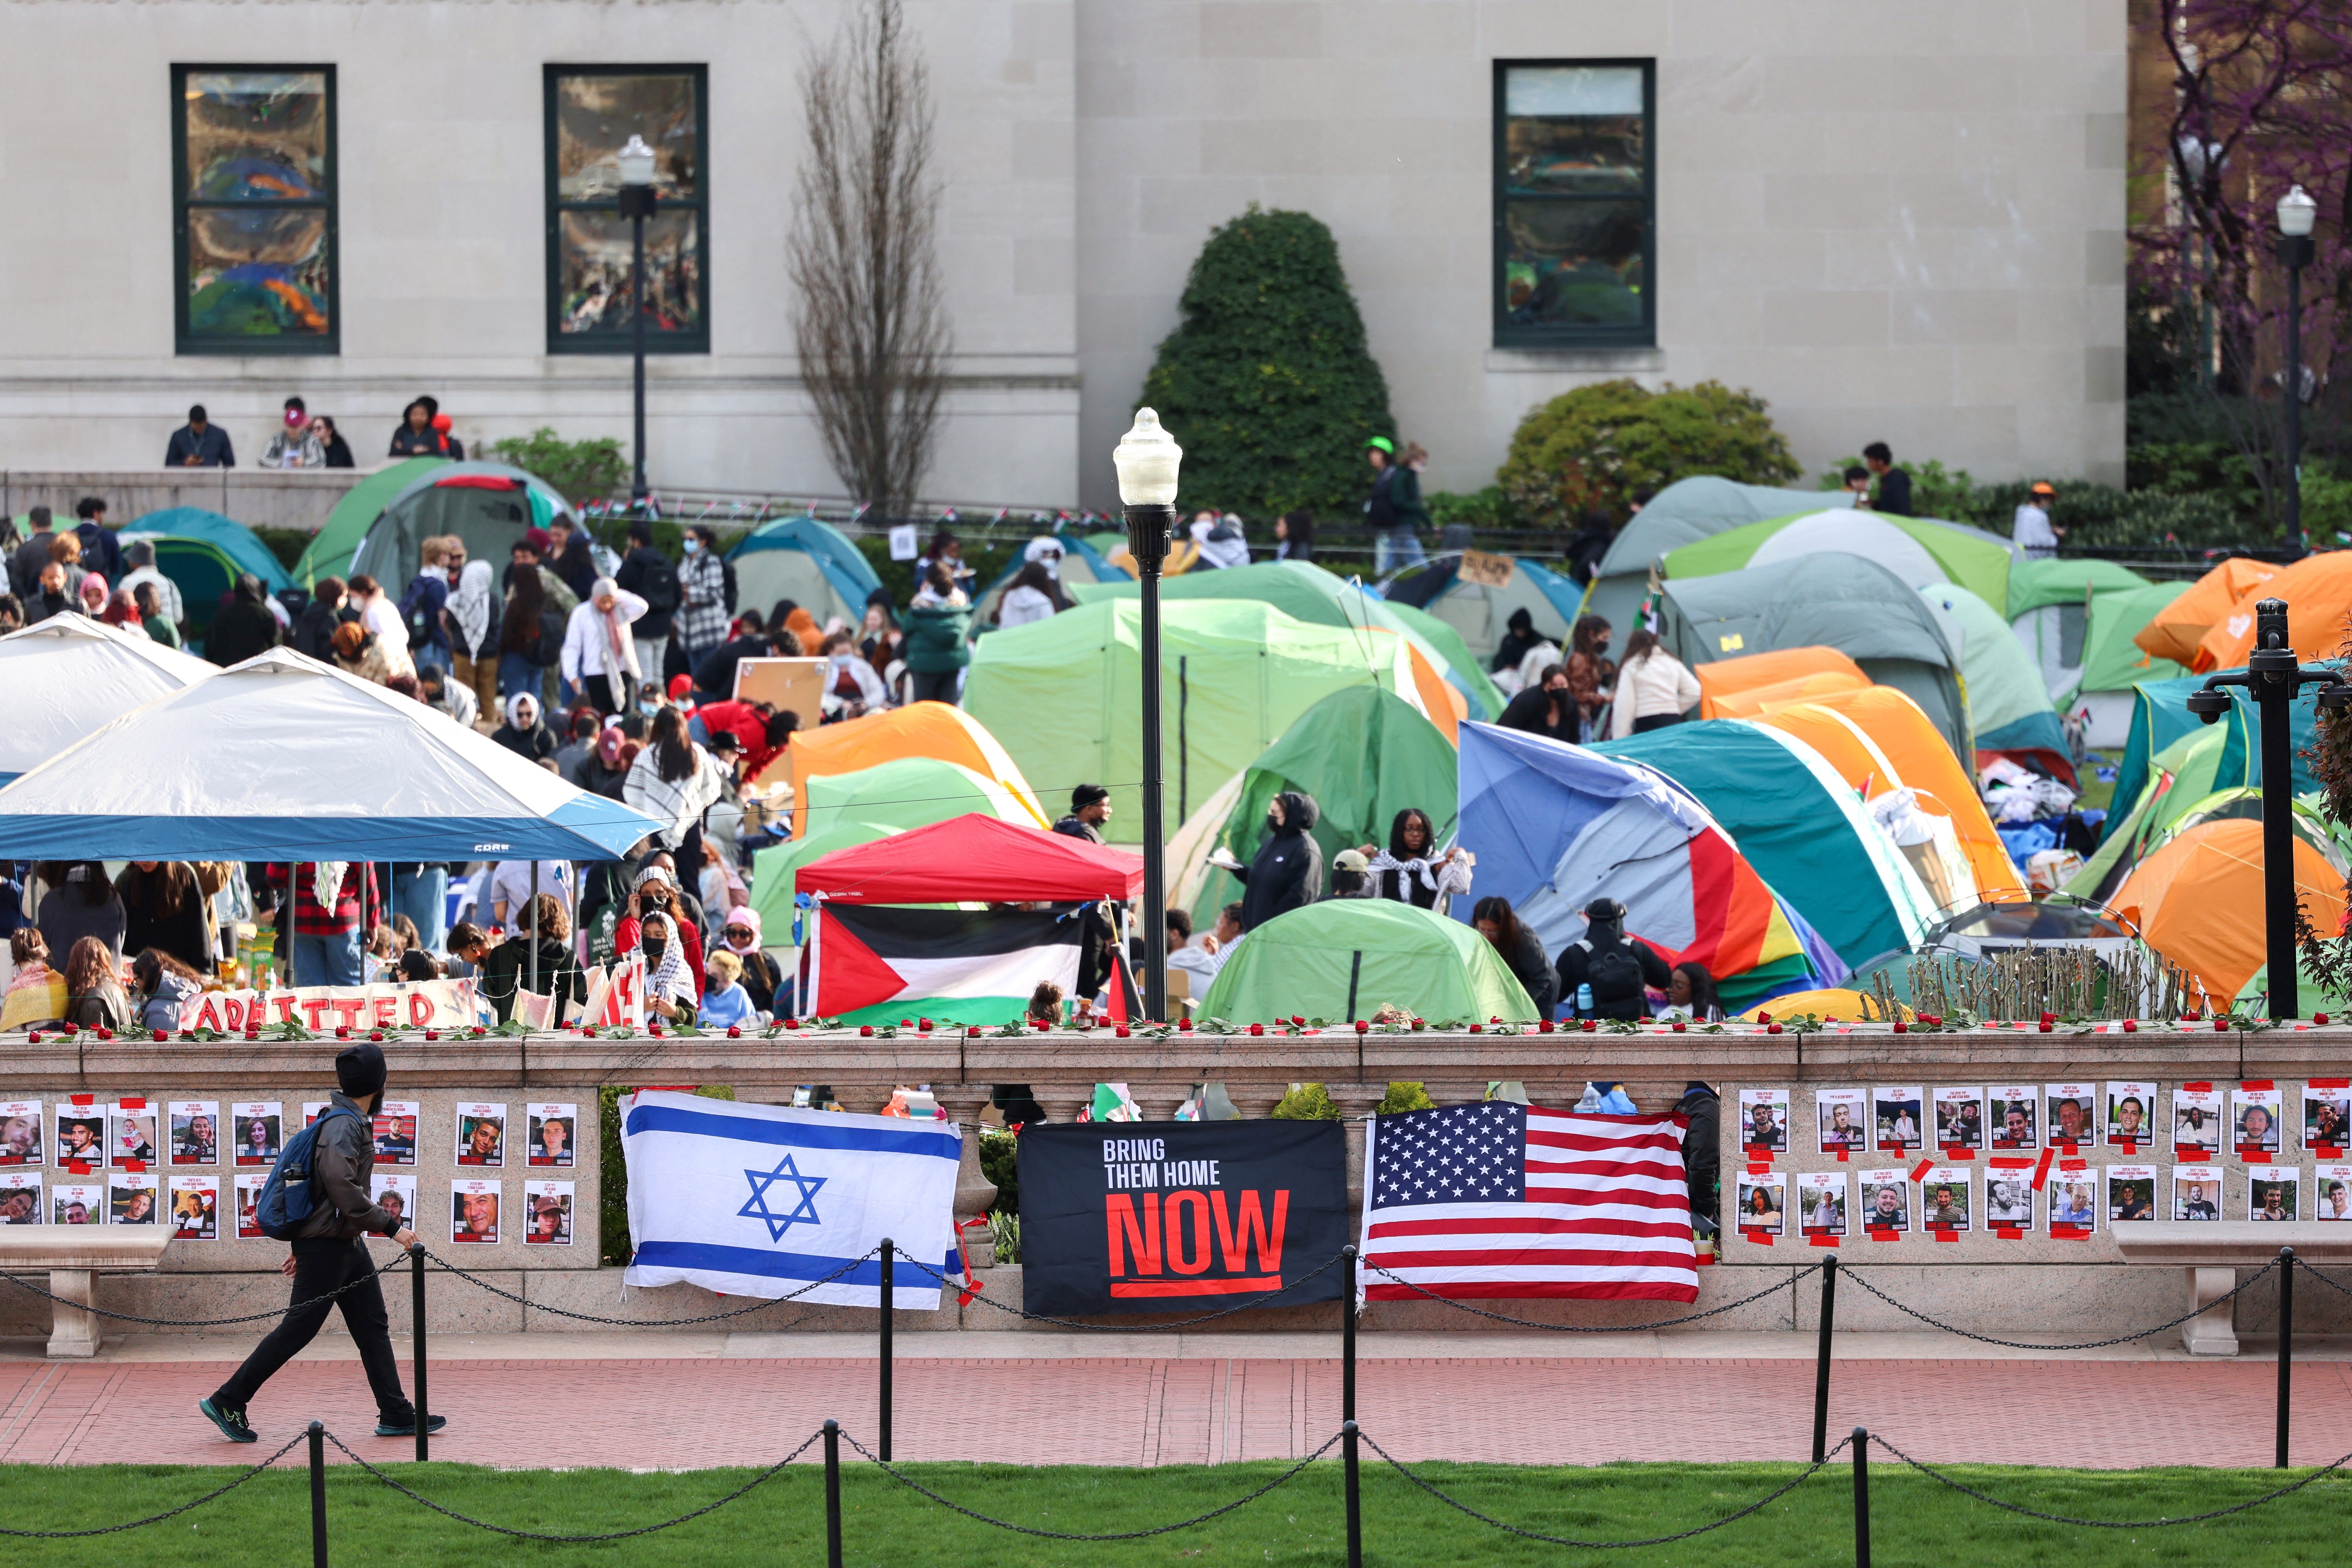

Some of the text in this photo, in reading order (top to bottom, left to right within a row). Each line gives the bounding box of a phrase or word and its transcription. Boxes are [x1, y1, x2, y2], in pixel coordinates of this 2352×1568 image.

[1103, 1139, 1165, 1162] BRING
[1105, 1160, 1220, 1189] THEM HOME
[1105, 1190, 1289, 1277] NOW
